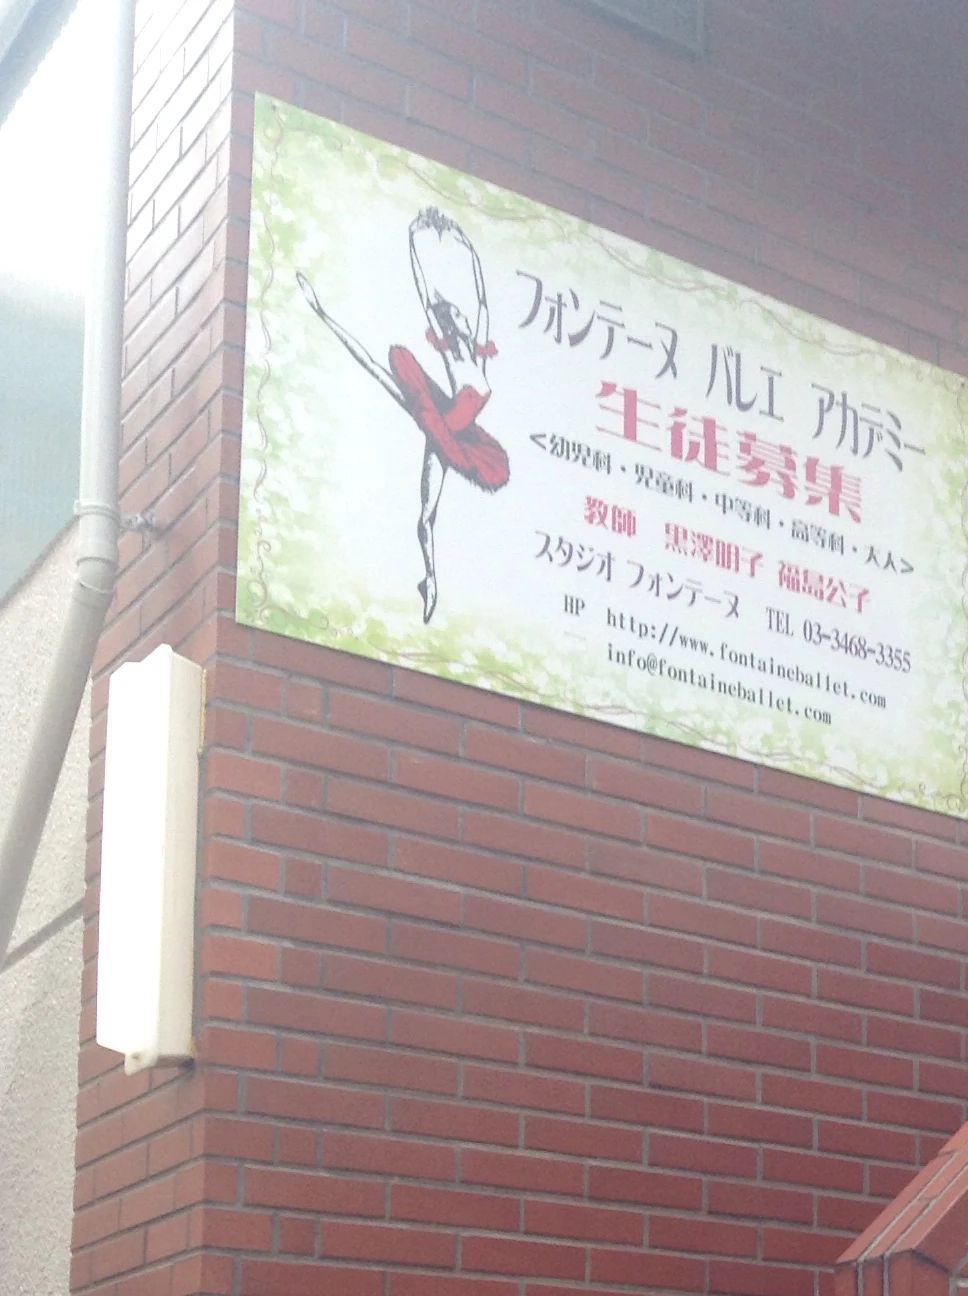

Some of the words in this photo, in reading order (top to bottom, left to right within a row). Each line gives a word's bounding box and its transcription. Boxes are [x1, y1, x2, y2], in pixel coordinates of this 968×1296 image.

[516, 269, 678, 379] フォンテーヌ
[705, 343, 784, 422] バレエ
[811, 382, 926, 473] アカデミー
[595, 380, 862, 524] 生徒募集
[534, 530, 615, 583] スタジオ
[626, 559, 740, 619] フォンテーヌ
[766, 606, 795, 642] TEL
[803, 618, 912, 674] 03-3468-3355
[583, 495, 637, 538] 教師
[664, 522, 764, 578] 黒澤明子
[778, 560, 871, 614] 福島公子
[564, 594, 585, 616] HP
[606, 607, 887, 710] http://www.fontaineballet.com
[607, 642, 832, 725] info@fontaineballet.com
